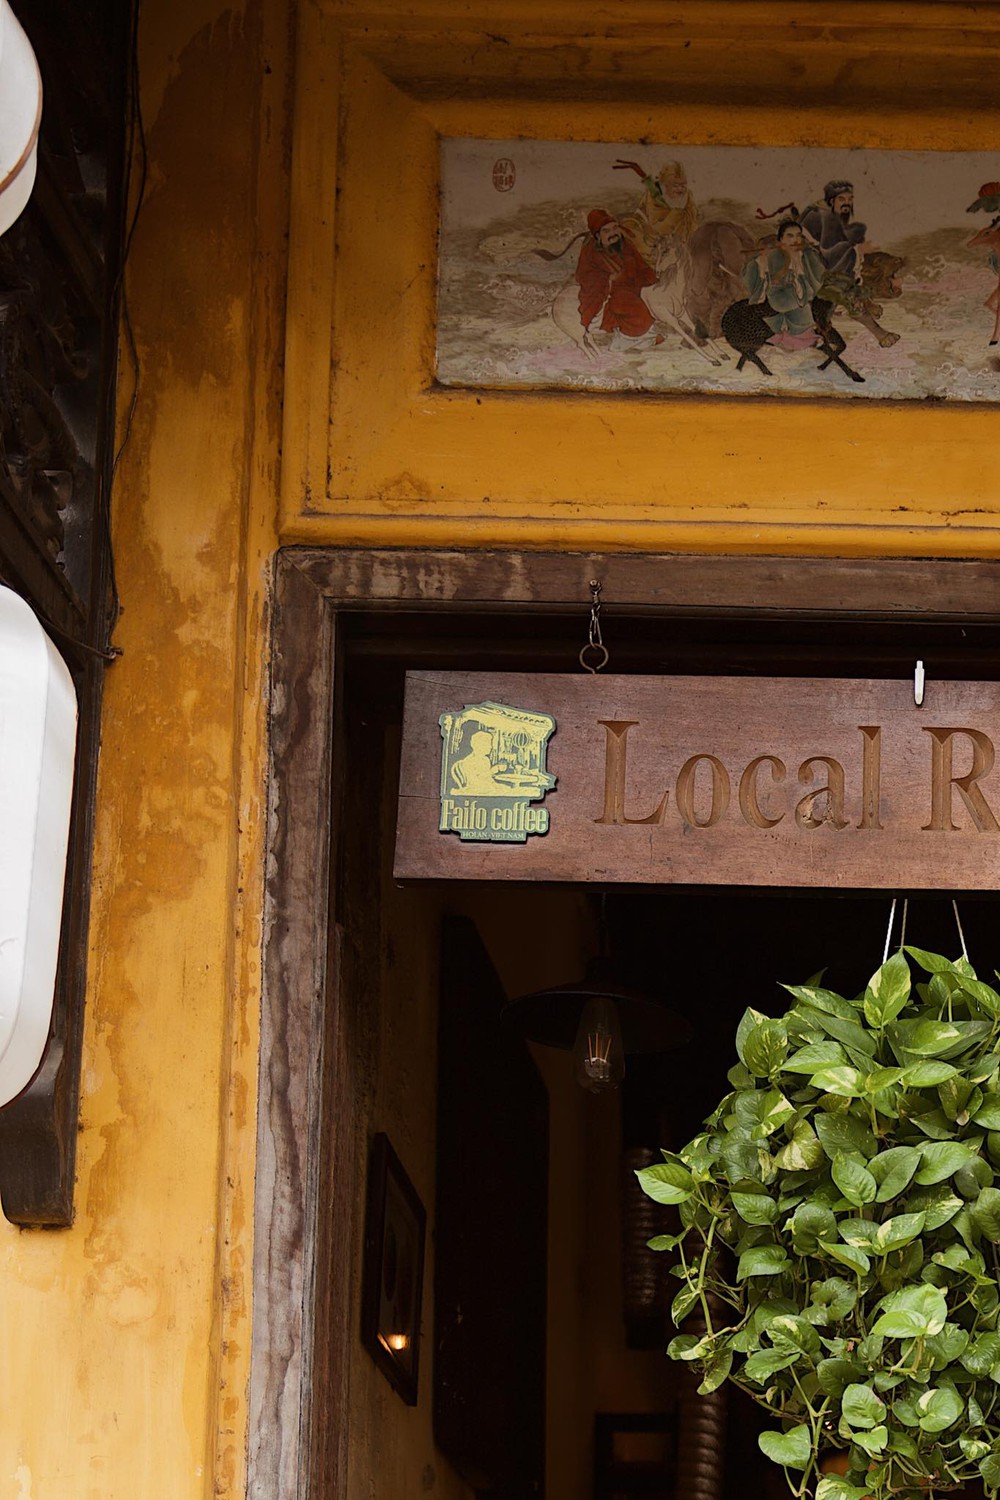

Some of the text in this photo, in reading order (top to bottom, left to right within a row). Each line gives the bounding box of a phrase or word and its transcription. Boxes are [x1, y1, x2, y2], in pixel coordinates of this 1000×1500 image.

[594, 720, 885, 829] Local
[442, 799, 547, 833] Faifo coffee
